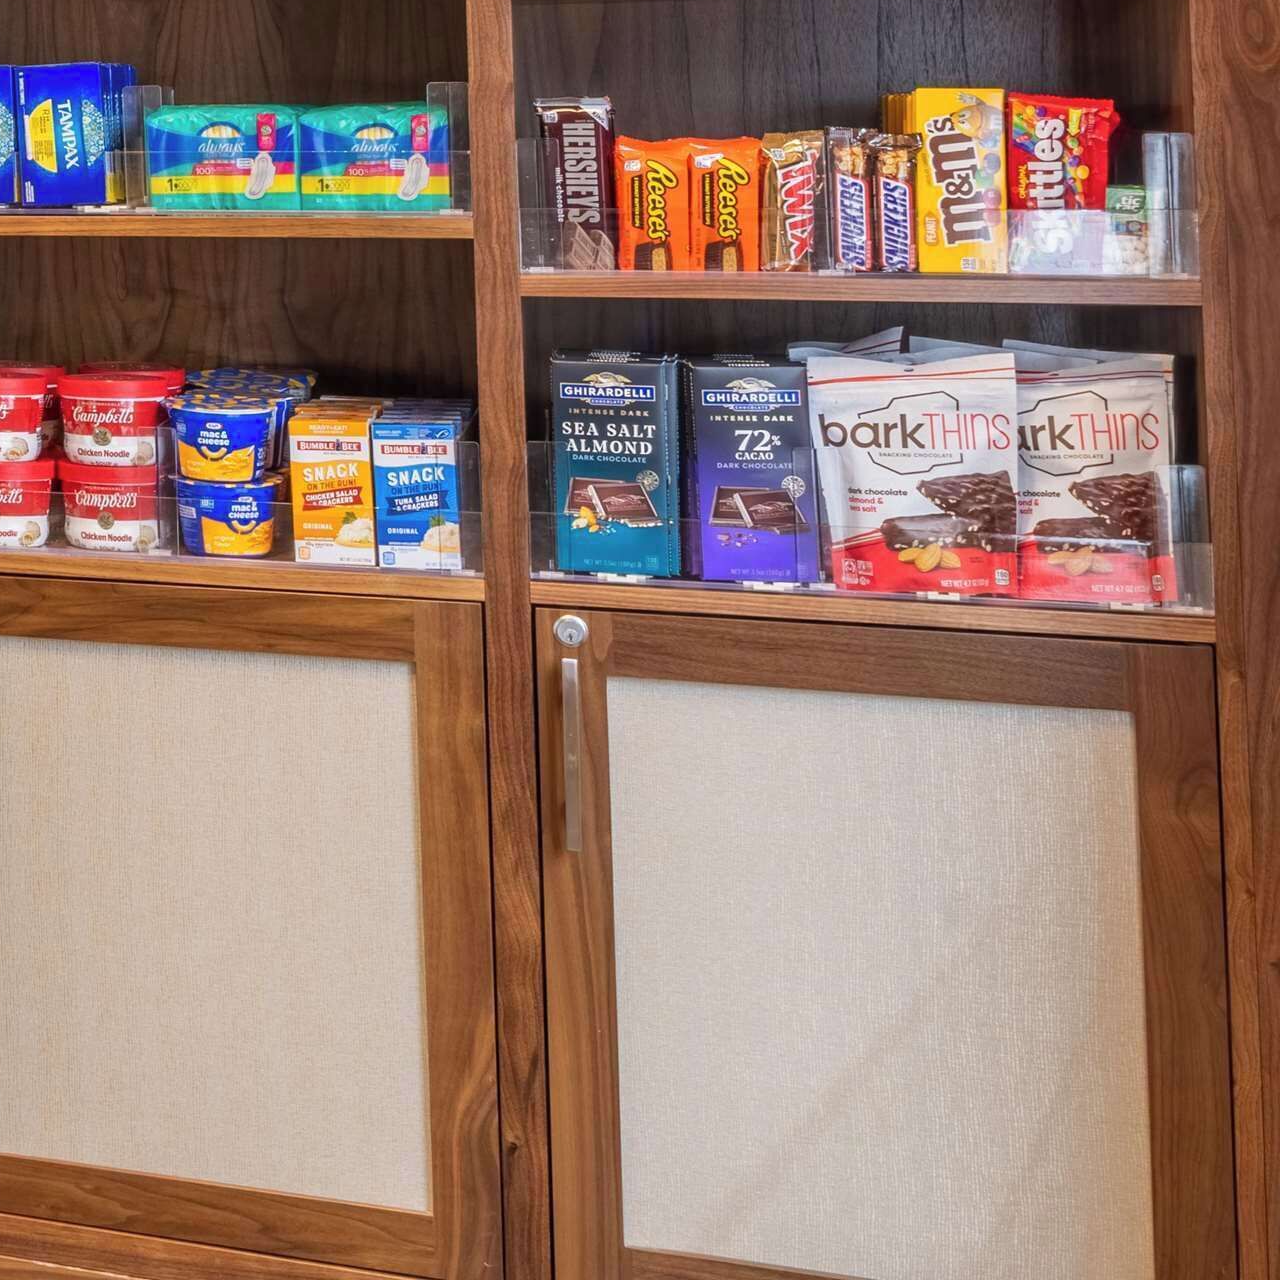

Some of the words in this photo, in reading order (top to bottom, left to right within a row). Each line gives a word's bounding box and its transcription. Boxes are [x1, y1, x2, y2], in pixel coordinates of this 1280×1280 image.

[57, 99, 79, 169] TAMPAX
[198, 139, 245, 156] always
[352, 140, 398, 156] always
[562, 121, 600, 224] HERSHEY'S
[646, 160, 678, 242] Reese's
[717, 156, 750, 240] Reese's
[781, 149, 820, 263] TWIX
[838, 176, 866, 268] SNICKERS
[883, 180, 909, 269] SNICKERS
[564, 387, 651, 398] GHIRARDELLI
[706, 393, 796, 403] GHIRARDELLI
[72, 406, 134, 426] Campbell's
[200, 431, 217, 439] mac
[562, 422, 603, 437] SEA
[607, 423, 656, 438] SALT
[300, 441, 334, 450] BUMBLE
[342, 442, 359, 450] BEE
[565, 438, 653, 455] ALMOND
[734, 430, 781, 452] 72%
[597, 455, 647, 463] CHOCOLATE
[735, 452, 774, 461] CACAO
[303, 464, 358, 482] SNACK
[387, 467, 445, 486] SNACK
